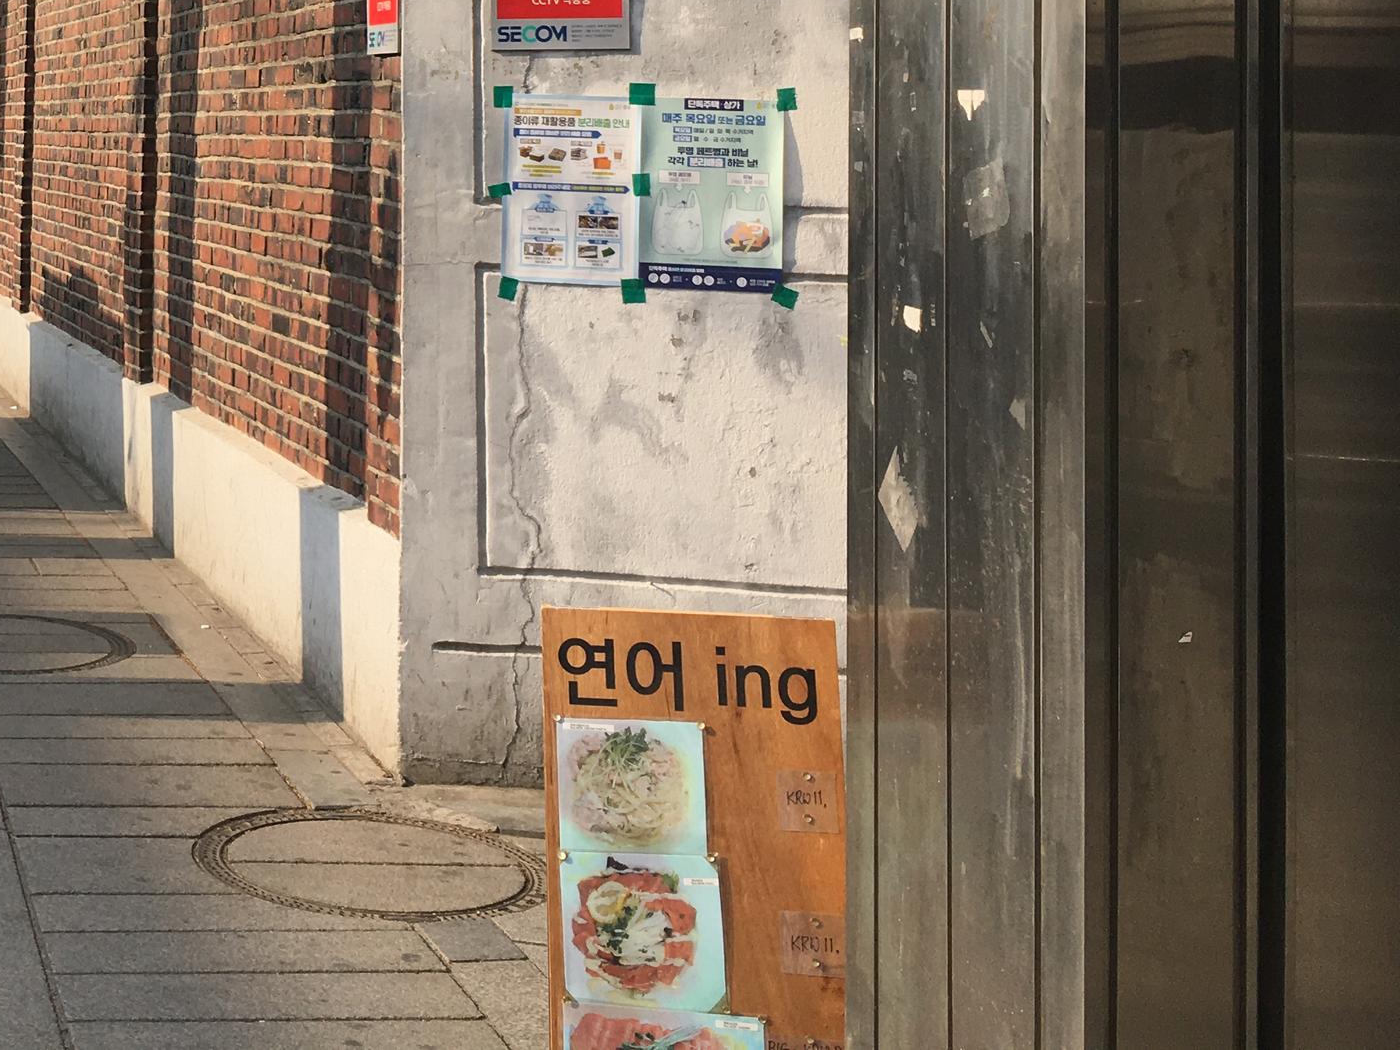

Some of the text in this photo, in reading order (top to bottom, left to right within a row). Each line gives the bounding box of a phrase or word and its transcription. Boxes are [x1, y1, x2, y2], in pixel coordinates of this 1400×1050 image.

[497, 25, 567, 43] SECOM
[514, 115, 539, 126] 종이류
[541, 117, 576, 127] 재활용품
[613, 119, 630, 128] 안내
[662, 113, 766, 126] 매주 목요일 또는 금요일
[668, 157, 685, 165] 각각
[727, 158, 744, 168] 하는
[558, 638, 817, 725] 연어 ing
[786, 790, 811, 806] KRW
[791, 935, 820, 952] KRW
